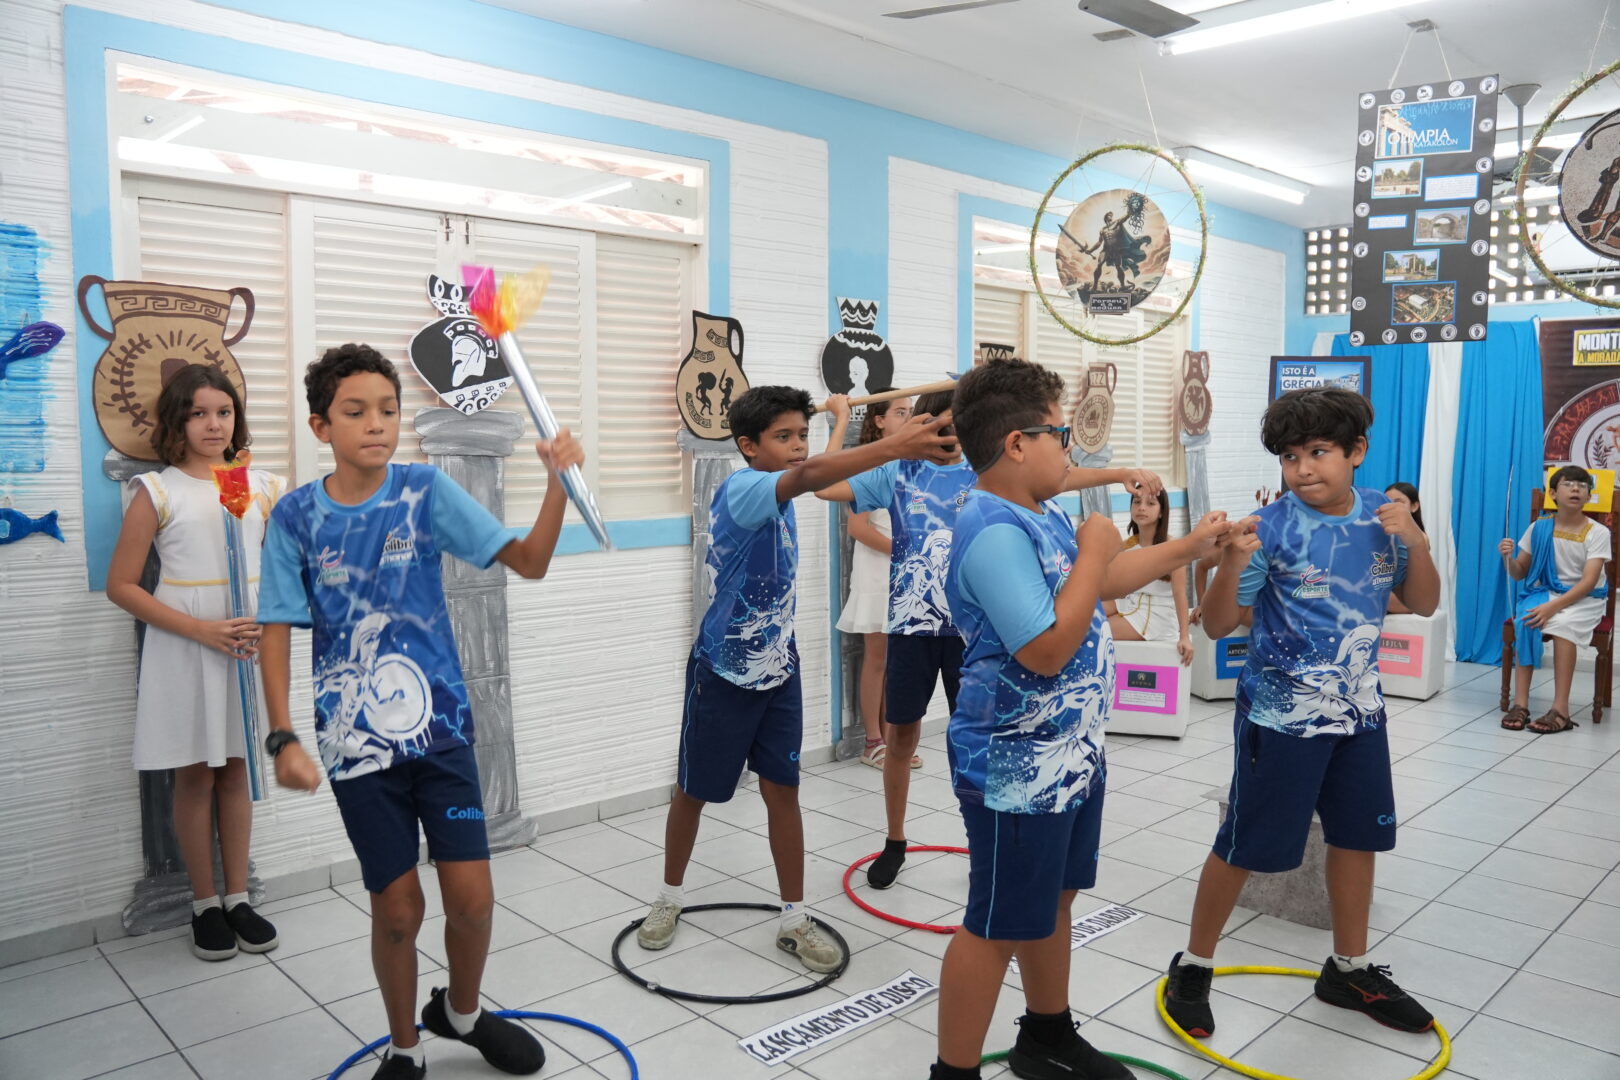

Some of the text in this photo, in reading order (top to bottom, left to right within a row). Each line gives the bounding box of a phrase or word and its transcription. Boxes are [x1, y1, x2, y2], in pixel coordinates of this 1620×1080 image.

[1388, 128, 1451, 145] OLIMPIA
[1413, 138, 1459, 149] KATAKOLON
[1578, 333, 1620, 351] MONT
[1578, 352, 1585, 363] A
[1282, 365, 1315, 375] ISTO É A
[1282, 377, 1322, 389] GRÉCIA
[1085, 907, 1137, 928] DARDO
[854, 993, 893, 1014] DE
[877, 976, 934, 1005] DISCO
